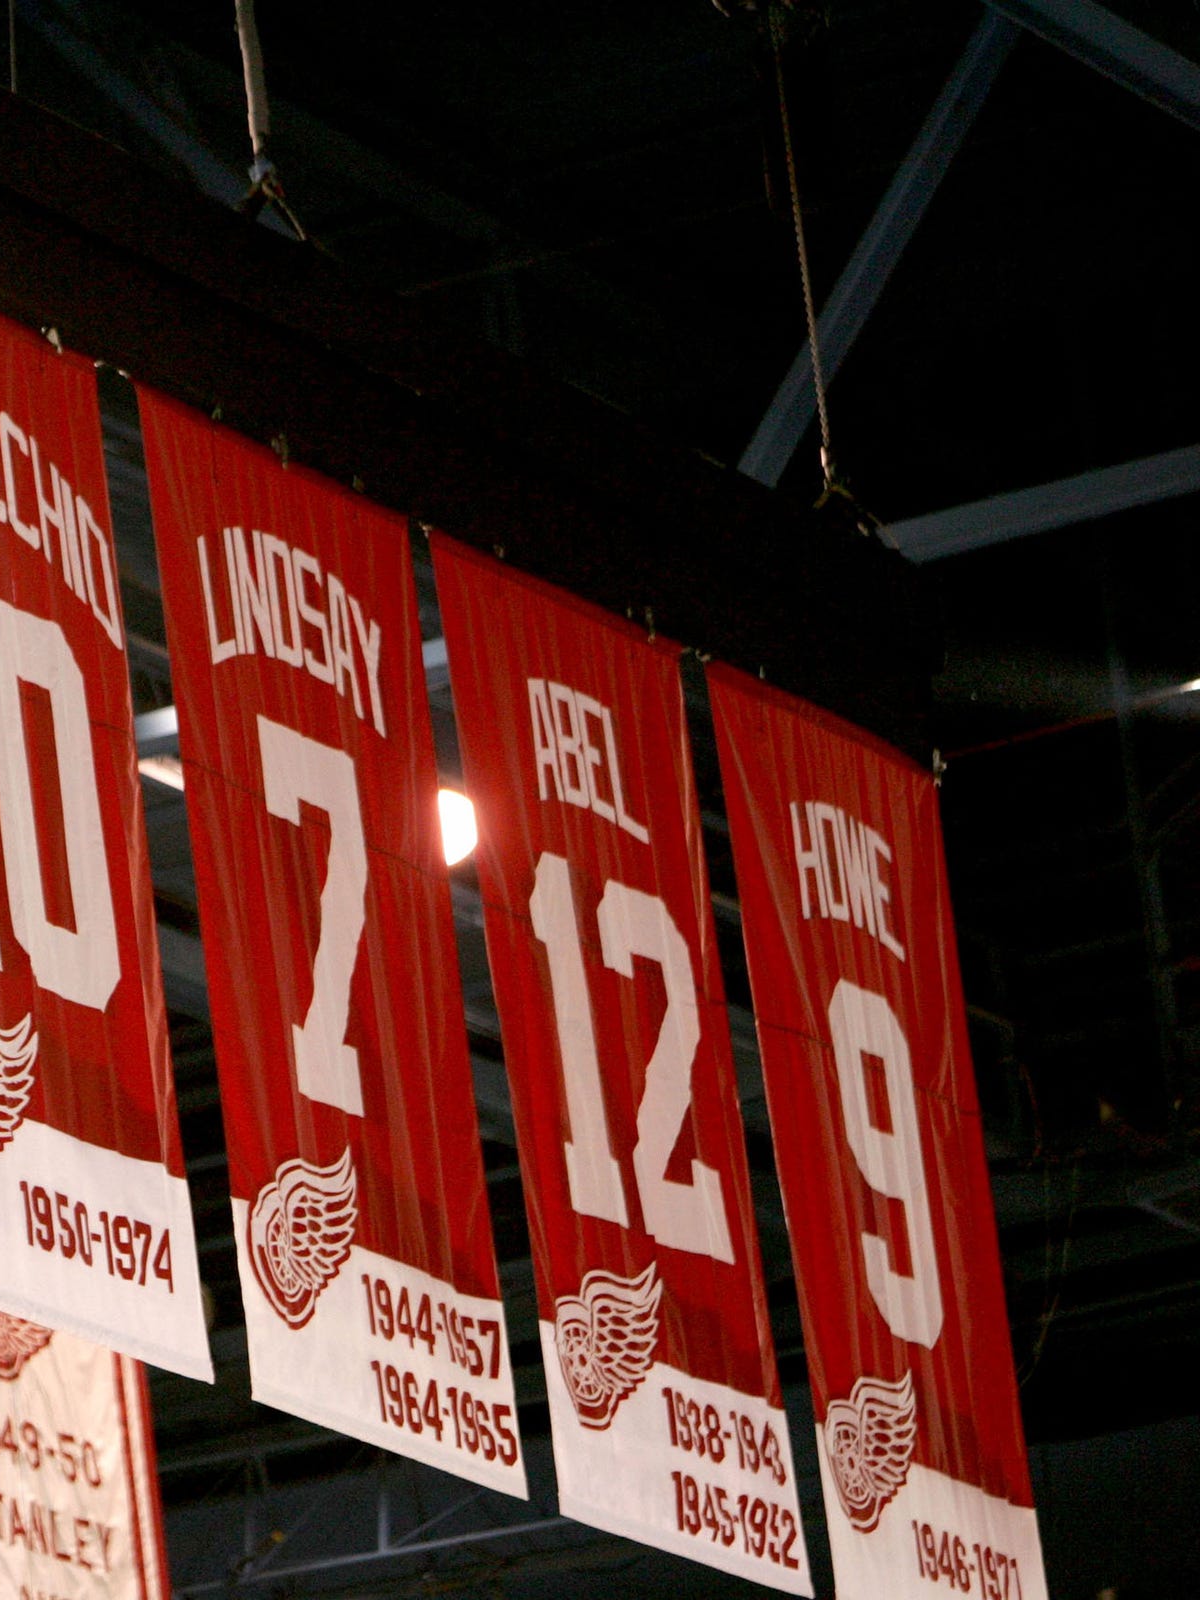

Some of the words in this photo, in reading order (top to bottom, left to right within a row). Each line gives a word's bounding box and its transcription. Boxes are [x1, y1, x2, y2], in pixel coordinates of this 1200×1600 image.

[197, 526, 386, 739] LINDSAY
[527, 678, 649, 844] ABEL
[256, 713, 368, 1118] 7
[789, 801, 906, 963] HOWE
[529, 851, 735, 1265] 12
[829, 977, 943, 1350] 9
[19, 1180, 174, 1294] 1950-1974
[361, 1273, 500, 1380] 1944-1957
[370, 1360, 518, 1467] 1964-1965
[661, 1386, 787, 1487] 1938-1943
[671, 1471, 799, 1570] 1945-1952
[910, 1519, 1022, 1600] 1946-1971
